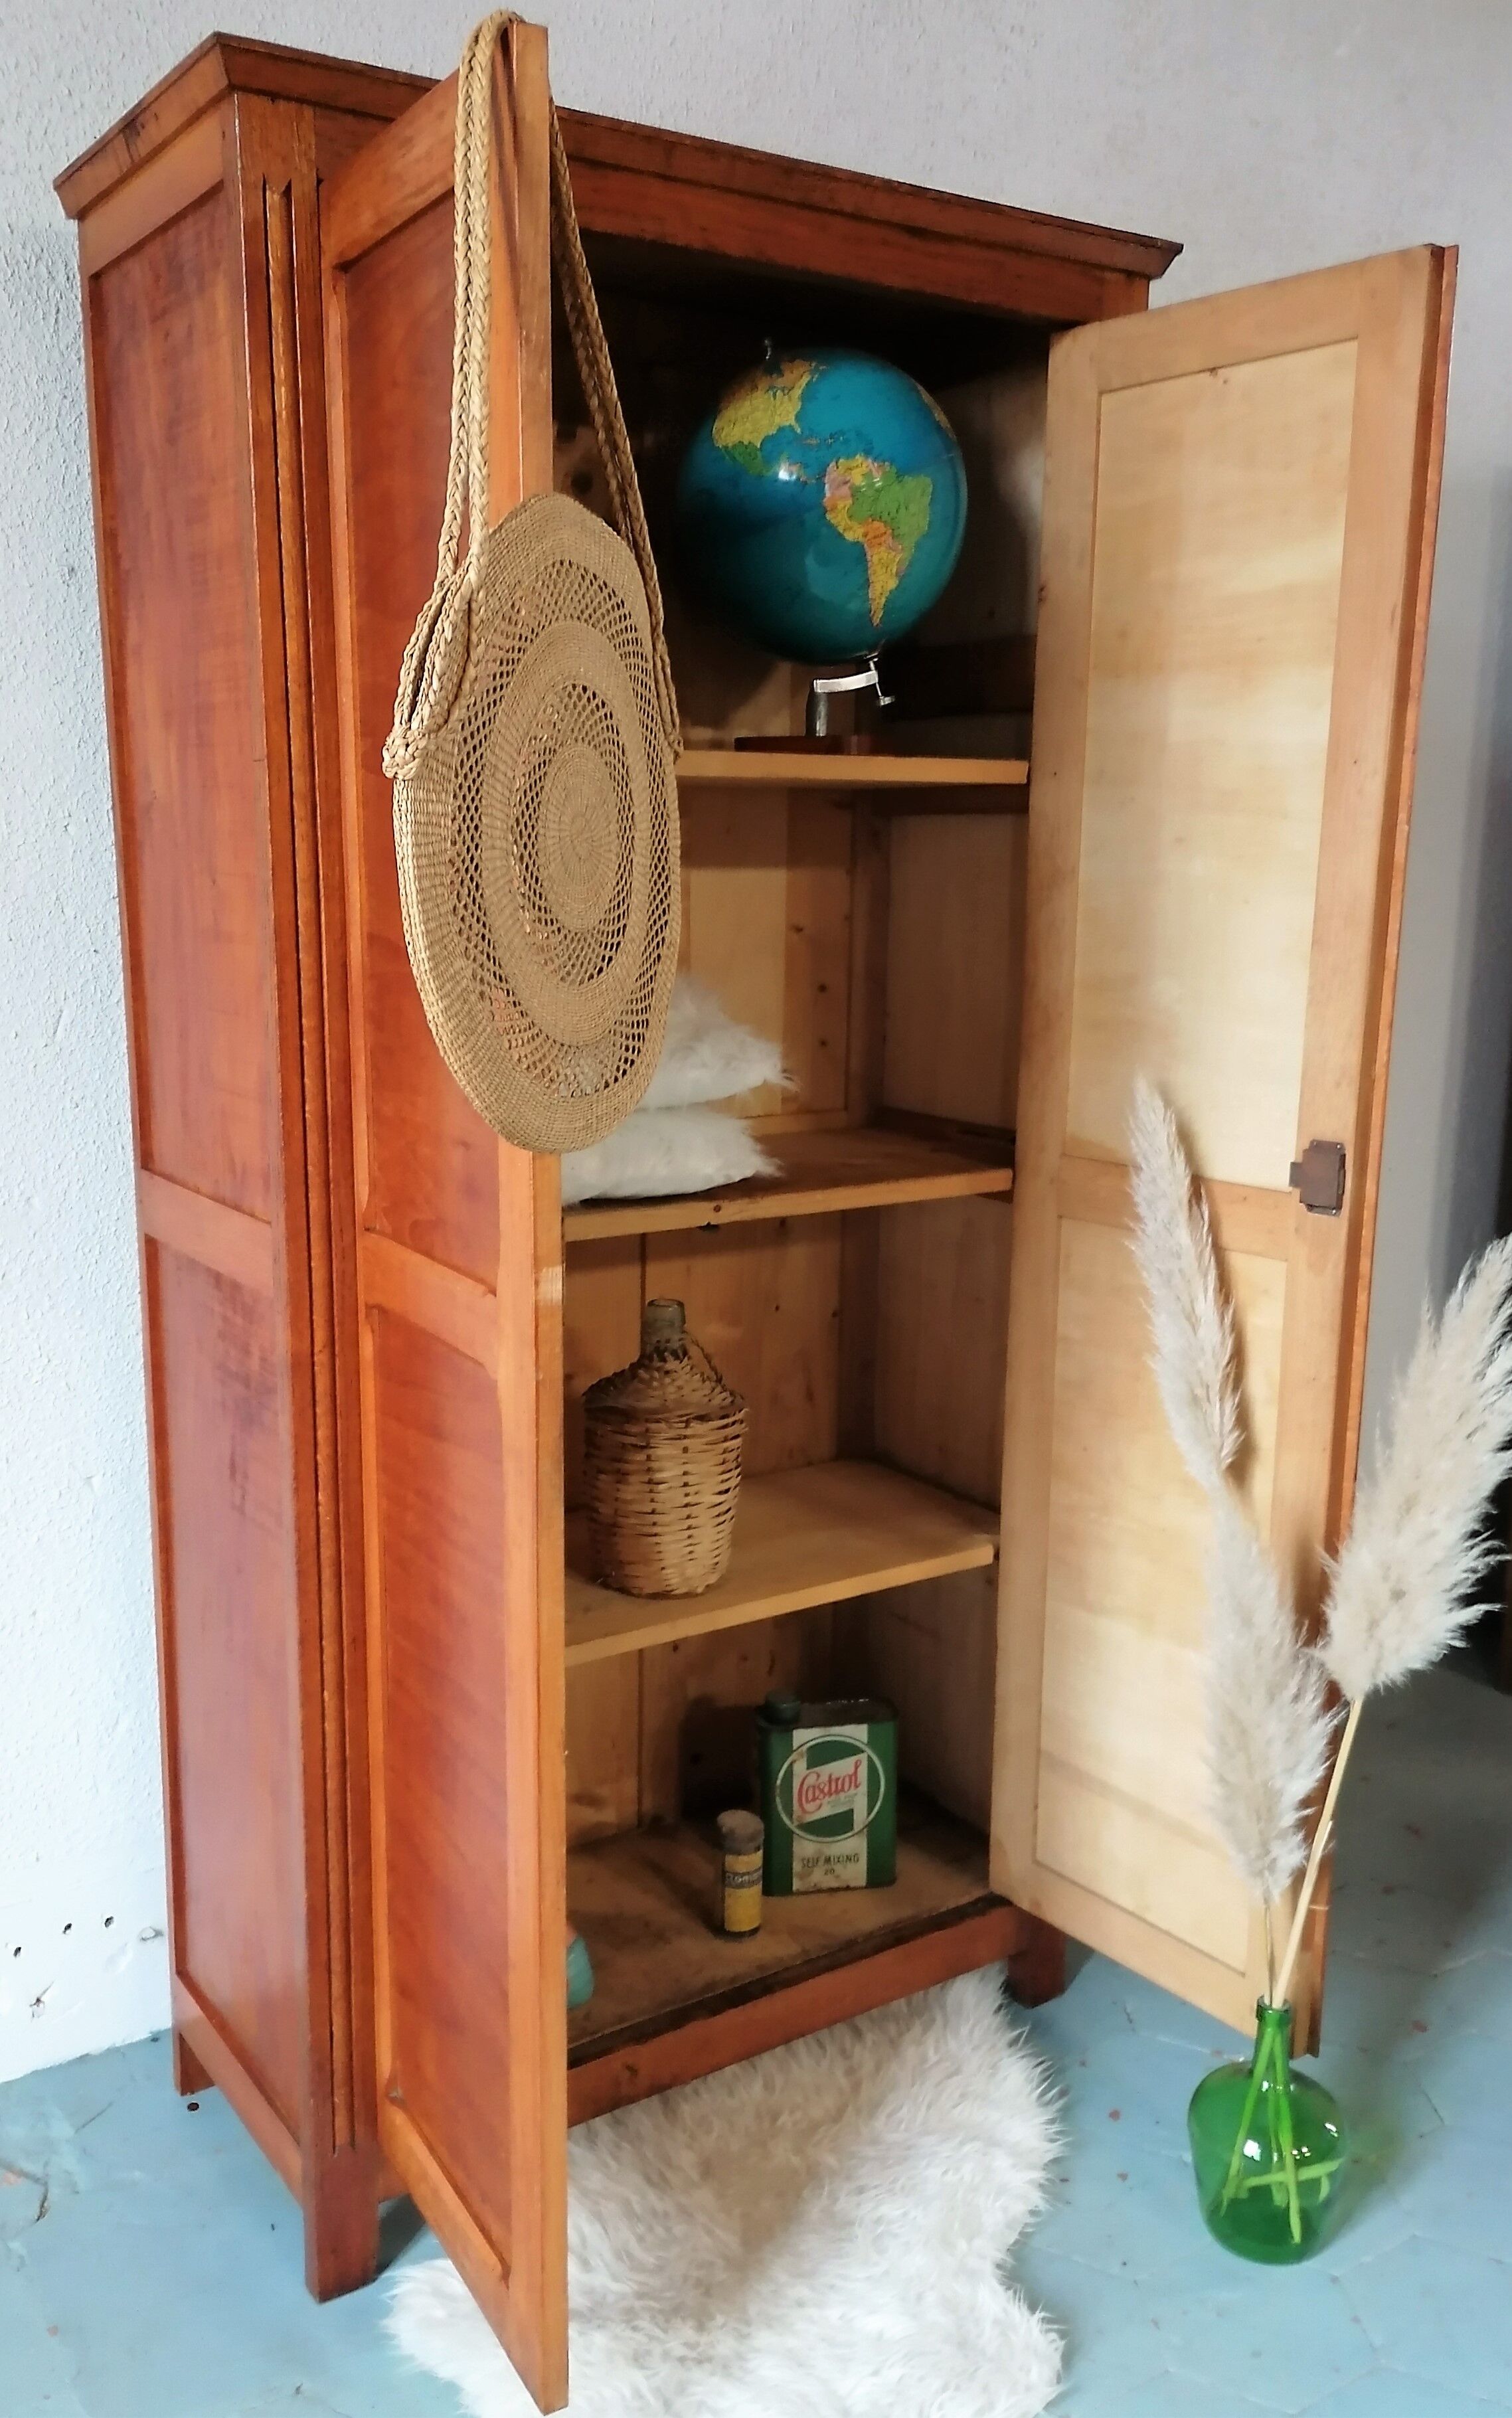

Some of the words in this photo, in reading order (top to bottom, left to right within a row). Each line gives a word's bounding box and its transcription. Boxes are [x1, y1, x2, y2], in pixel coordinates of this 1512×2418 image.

[798, 1759, 862, 1814] Castrol
[801, 1857, 819, 1868] SELF
[823, 1853, 859, 1866] MIXING
